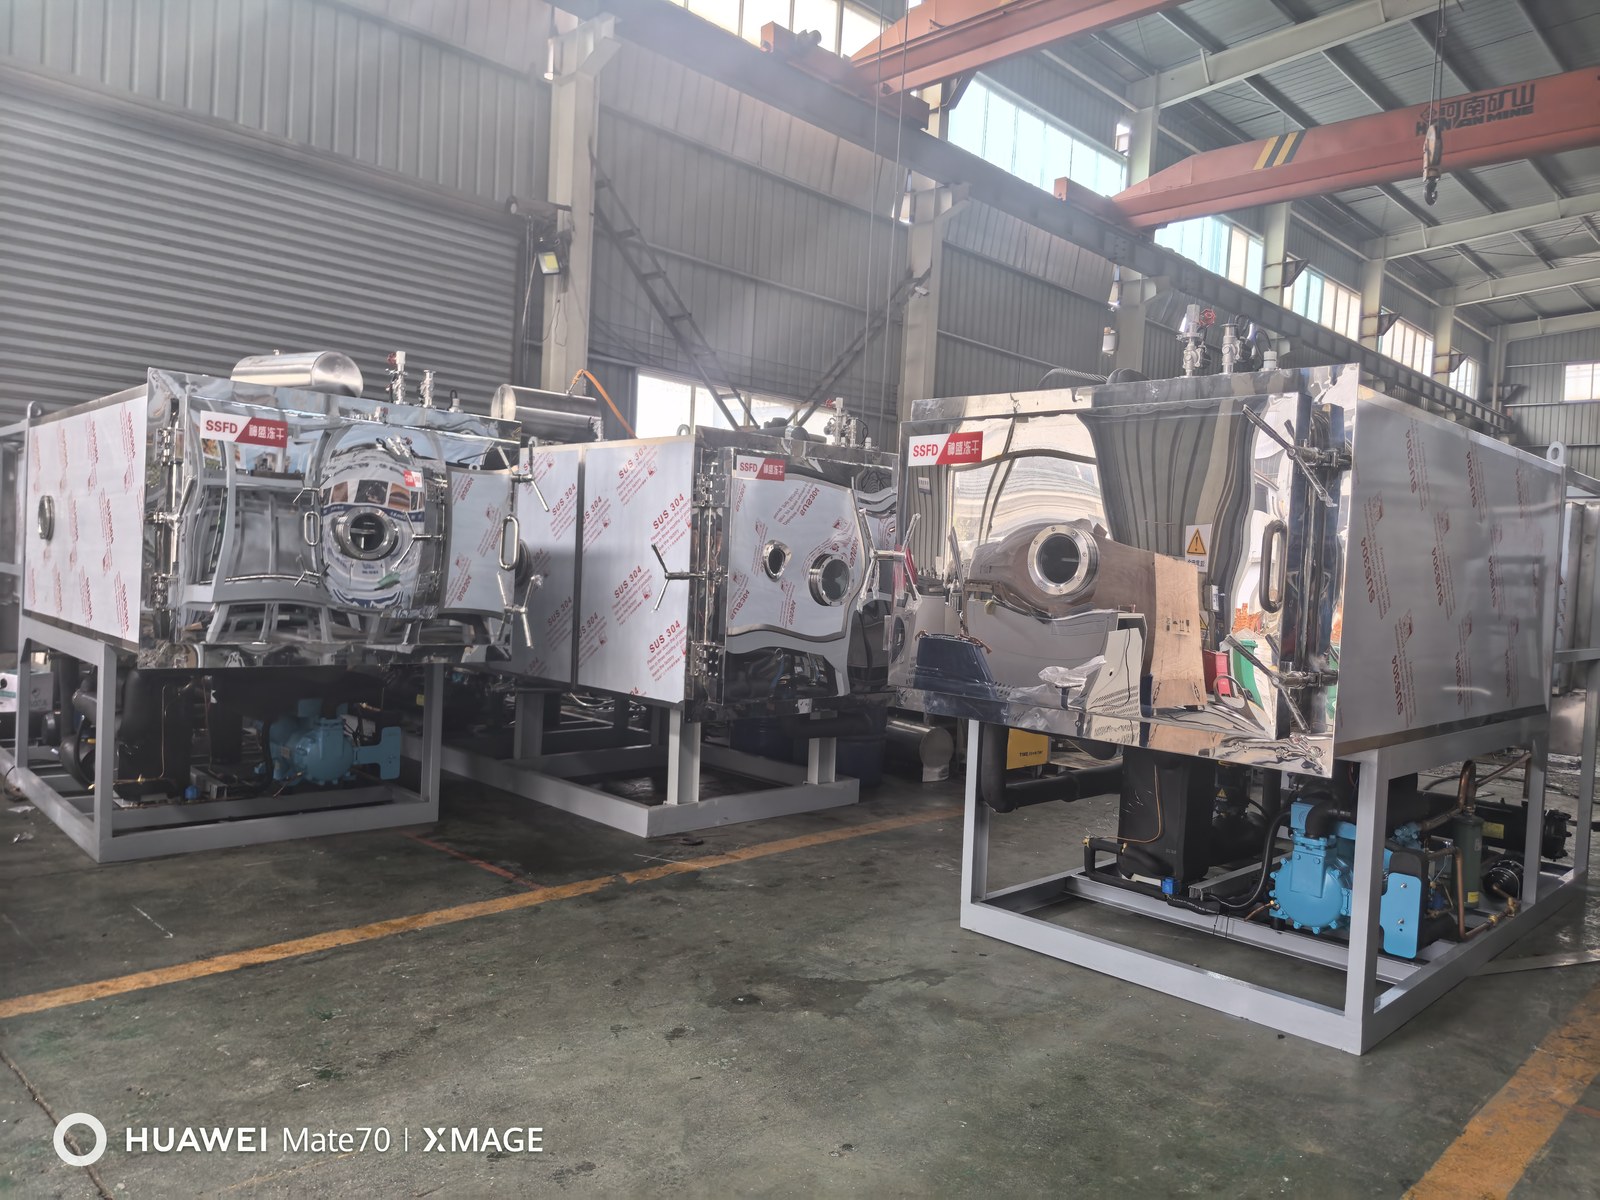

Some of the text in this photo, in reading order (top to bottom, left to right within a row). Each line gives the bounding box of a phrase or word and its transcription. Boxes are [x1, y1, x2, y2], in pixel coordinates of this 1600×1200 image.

[1416, 115, 1484, 137] HNAN
[206, 420, 238, 434] SSFD
[913, 443, 939, 457] SSFD
[618, 459, 634, 479] SUS
[739, 462, 758, 474] SSFD
[653, 493, 685, 530] SUS 304
[614, 565, 642, 599] SUS 304
[1360, 537, 1376, 603] SUS304
[649, 620, 681, 653] SUS 304
[1391, 655, 1404, 716] SUS304
